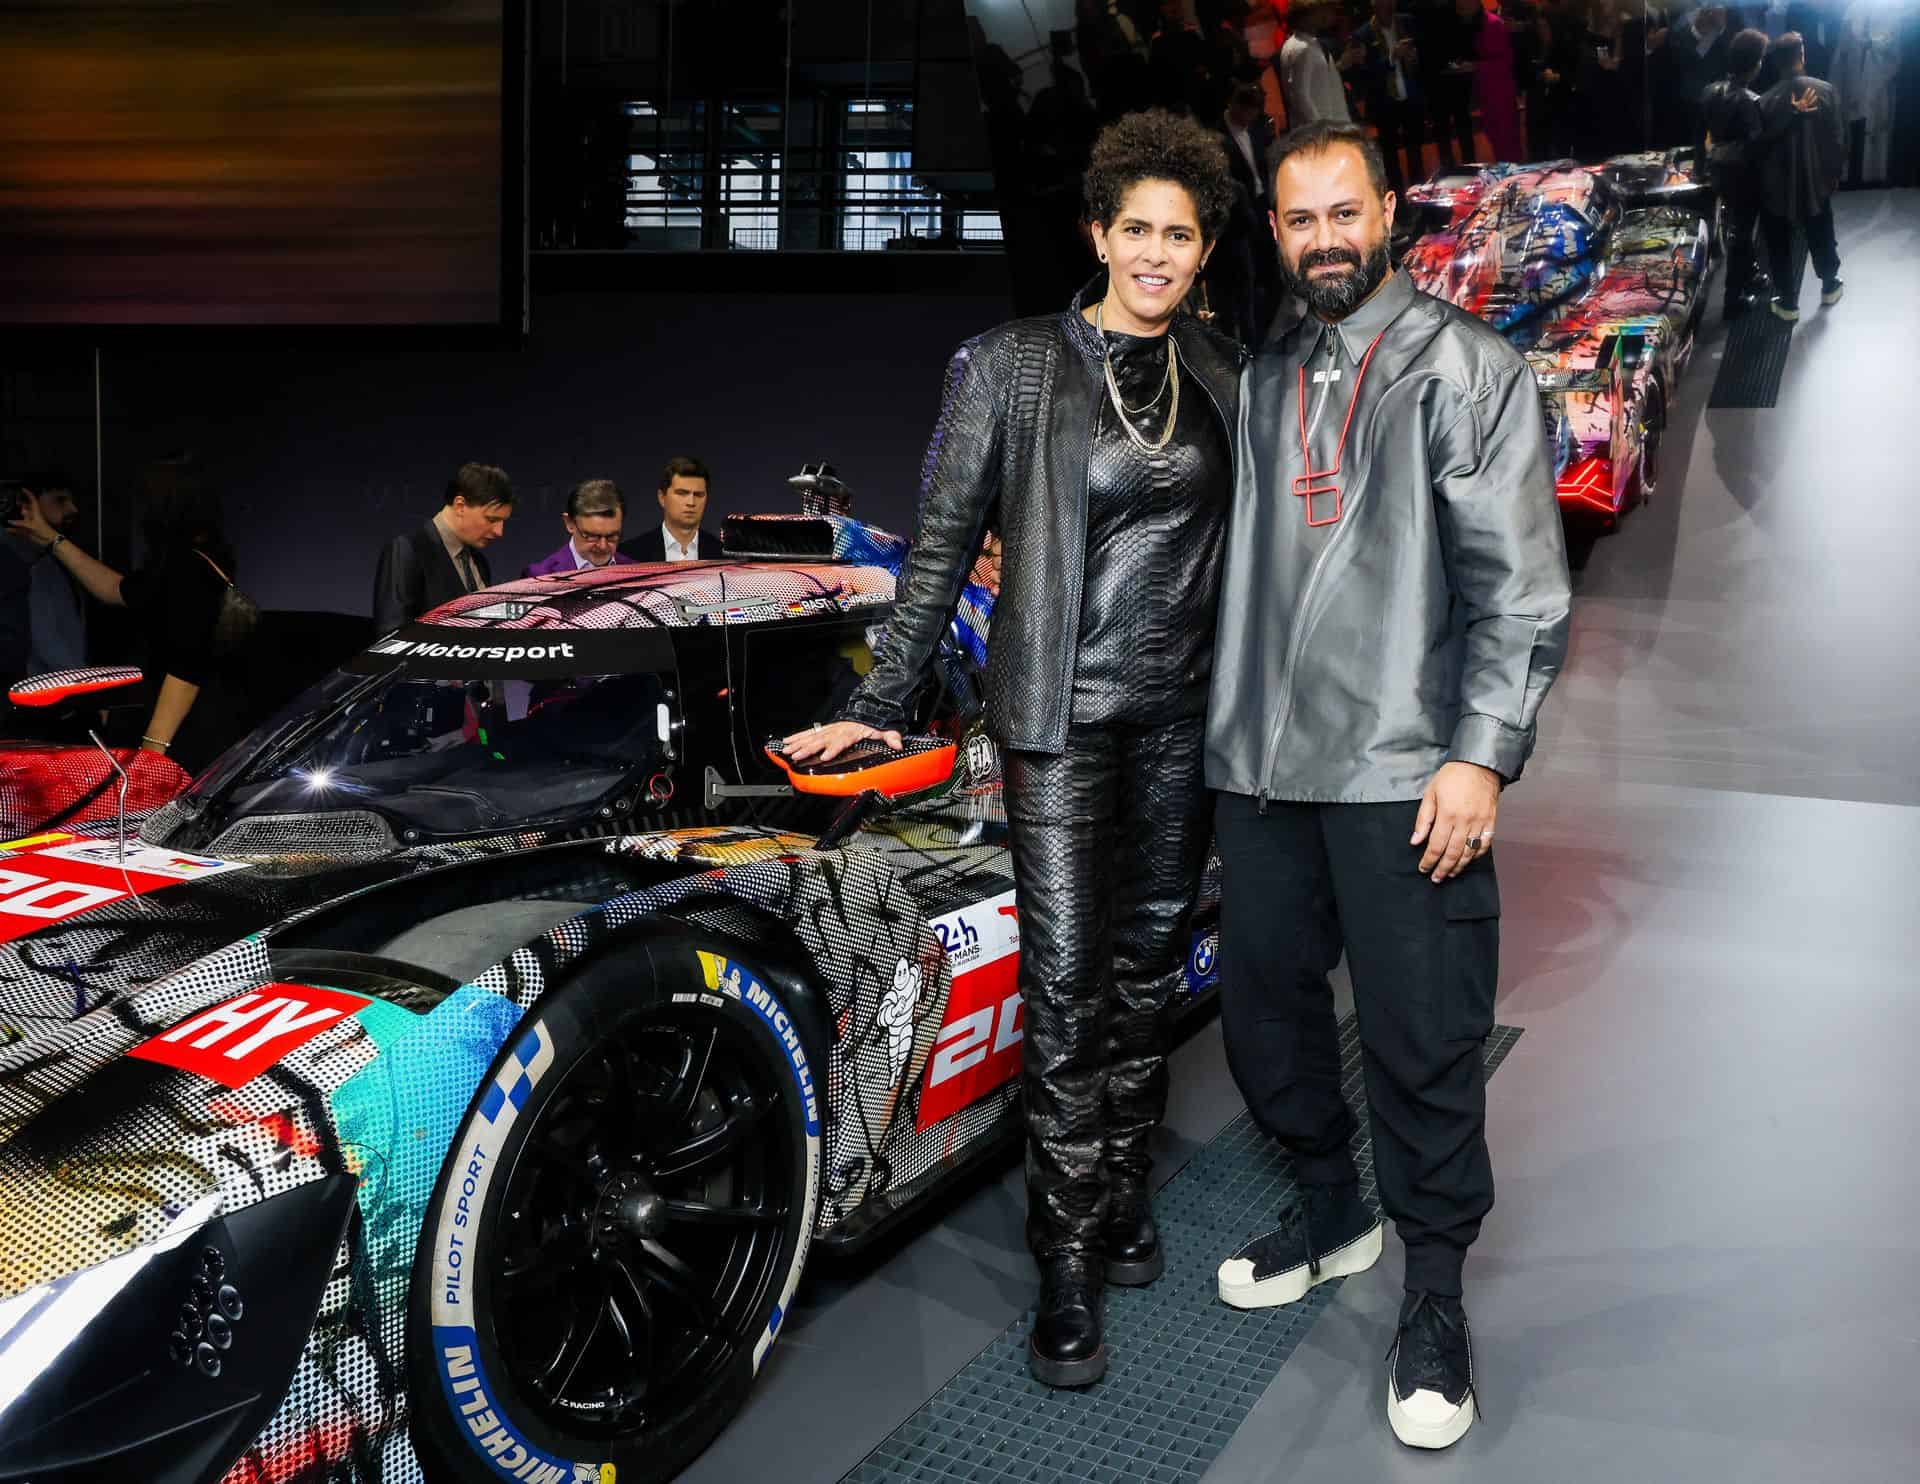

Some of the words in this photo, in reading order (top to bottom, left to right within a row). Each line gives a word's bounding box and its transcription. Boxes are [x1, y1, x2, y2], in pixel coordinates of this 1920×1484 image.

[801, 598, 830, 610] RAST
[408, 642, 574, 663] Motorsport
[934, 916, 979, 953] 24h
[954, 944, 980, 961] MANS
[160, 994, 344, 1060] HY
[745, 981, 818, 1122] MICHELIN
[454, 1143, 486, 1229] SPORT
[446, 1233, 464, 1305] PILOT
[444, 1345, 567, 1484] MICHELIN
